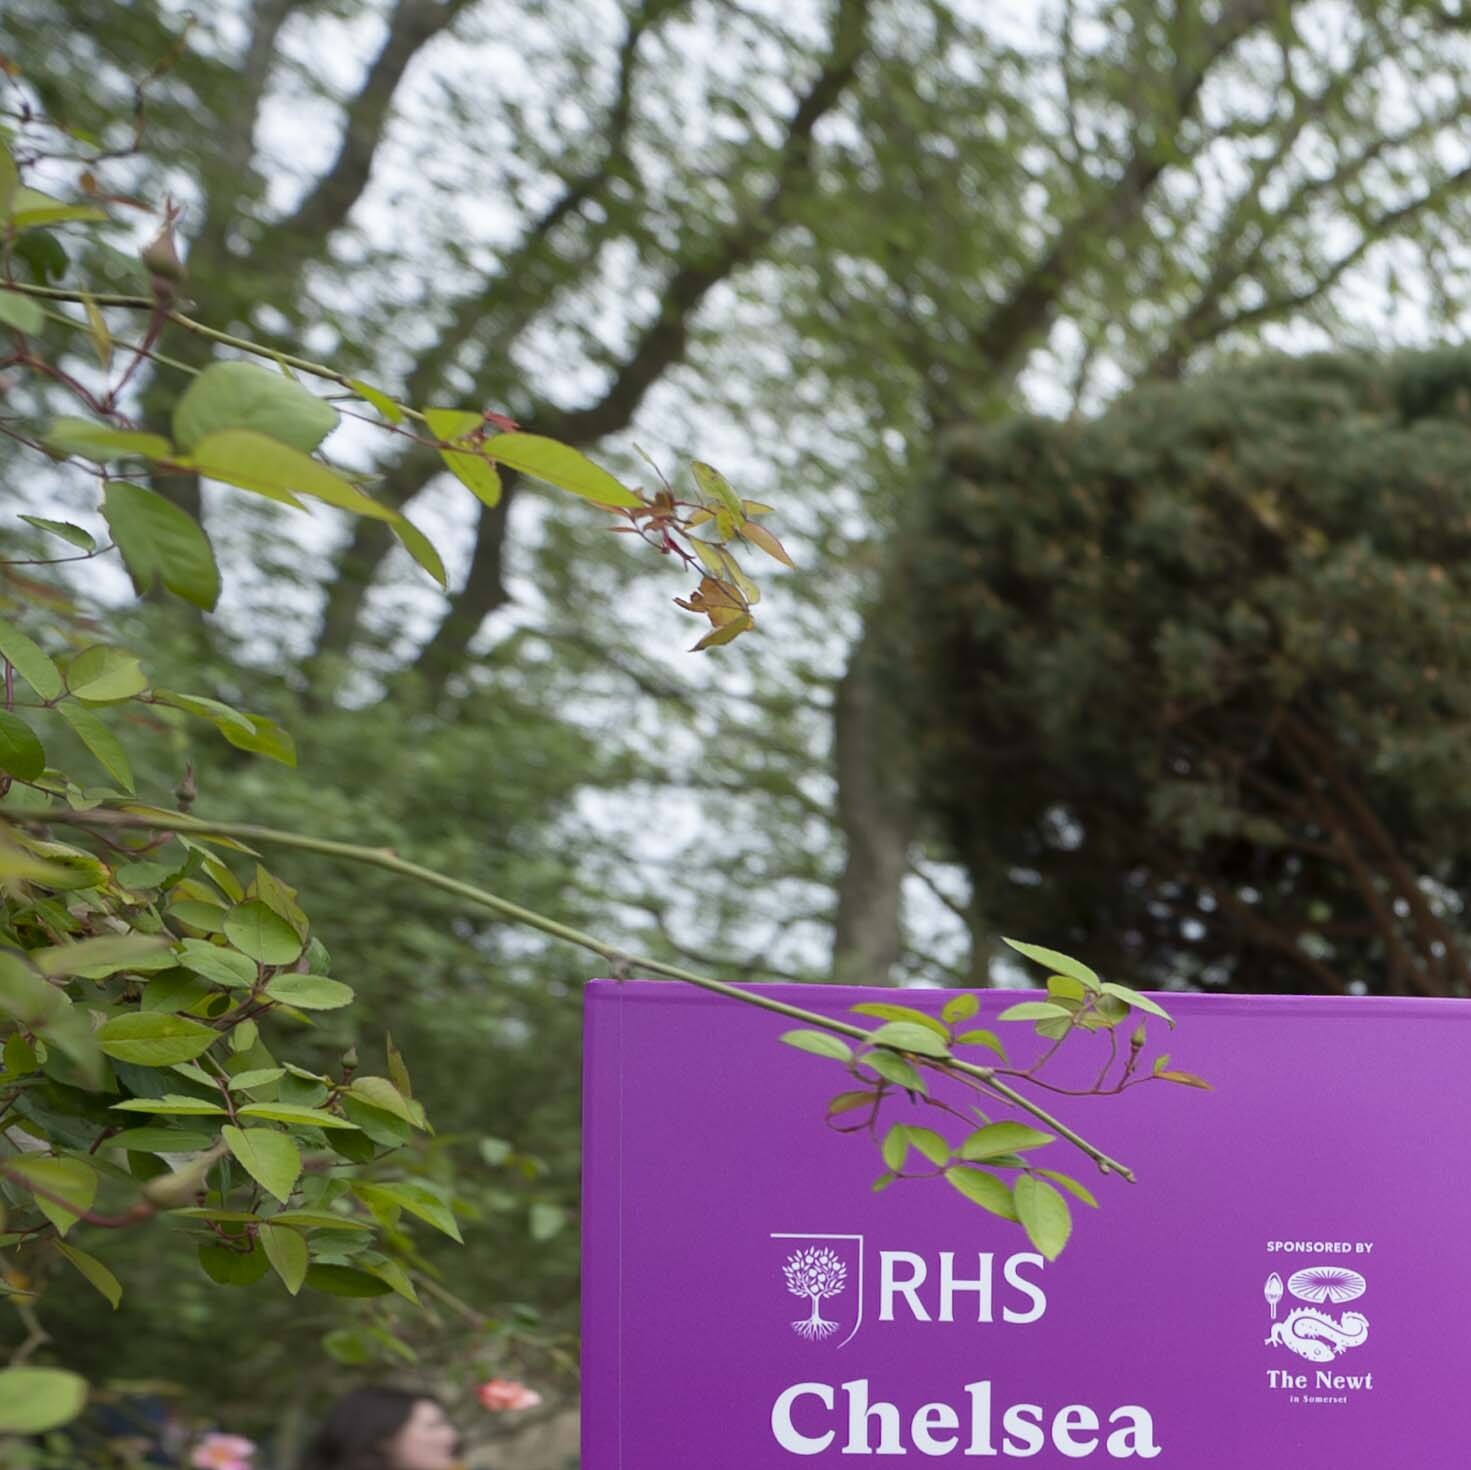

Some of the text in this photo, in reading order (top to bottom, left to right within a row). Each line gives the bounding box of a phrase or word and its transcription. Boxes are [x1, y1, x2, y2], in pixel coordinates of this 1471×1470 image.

[1266, 1240, 1374, 1254] SPONSORED BY
[878, 1250, 1048, 1324] RHS
[1266, 1369, 1373, 1390] The Newt
[1289, 1394, 1348, 1404] in Somerset
[770, 1378, 1163, 1459] Chelsea
